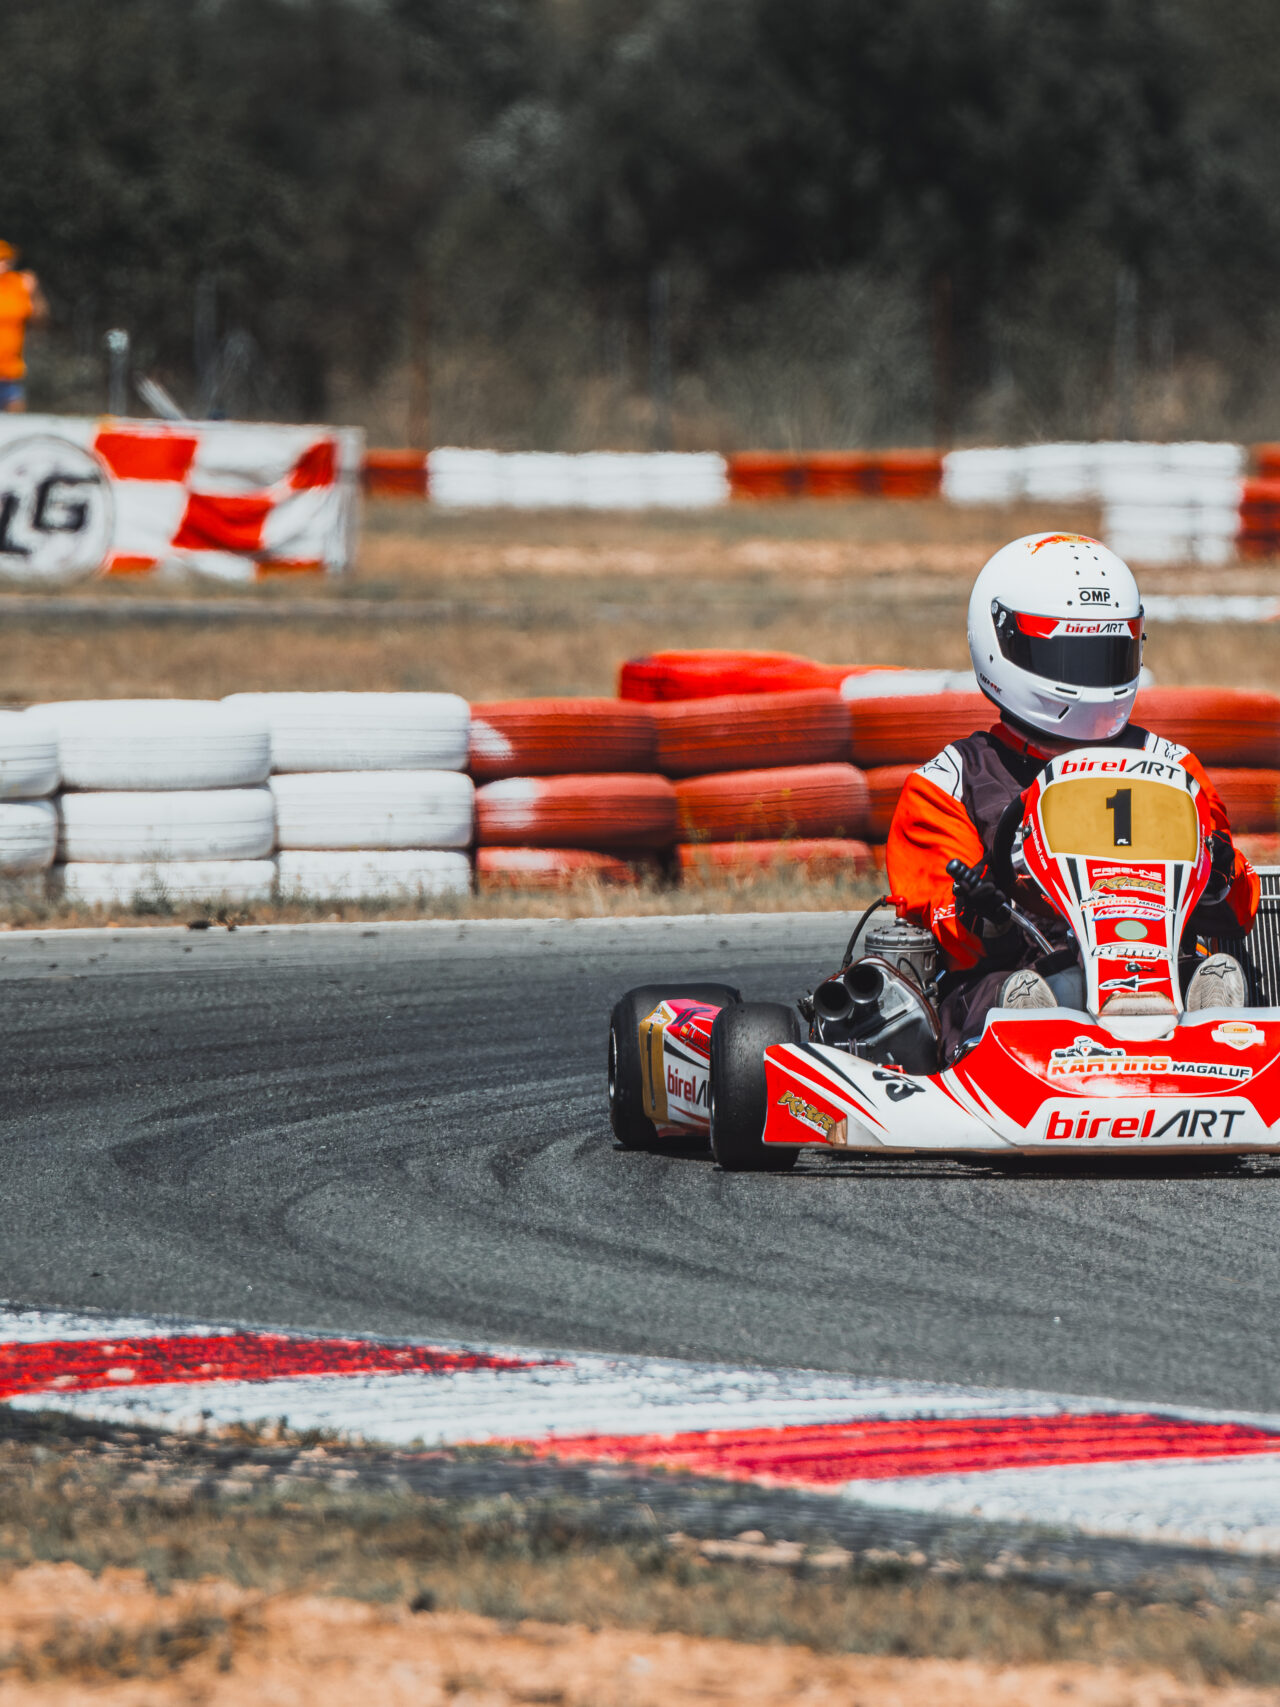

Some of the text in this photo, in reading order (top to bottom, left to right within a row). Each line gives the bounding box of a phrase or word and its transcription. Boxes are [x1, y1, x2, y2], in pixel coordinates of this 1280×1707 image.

[1079, 590, 1111, 602] OMP
[1065, 622, 1125, 633] birelART
[1061, 758, 1181, 779] birelART
[1106, 788, 1132, 846] 1
[1098, 908, 1161, 917] New Line
[1051, 1058, 1250, 1078] KARTING MAGALUF
[1044, 1109, 1245, 1140] birelART
